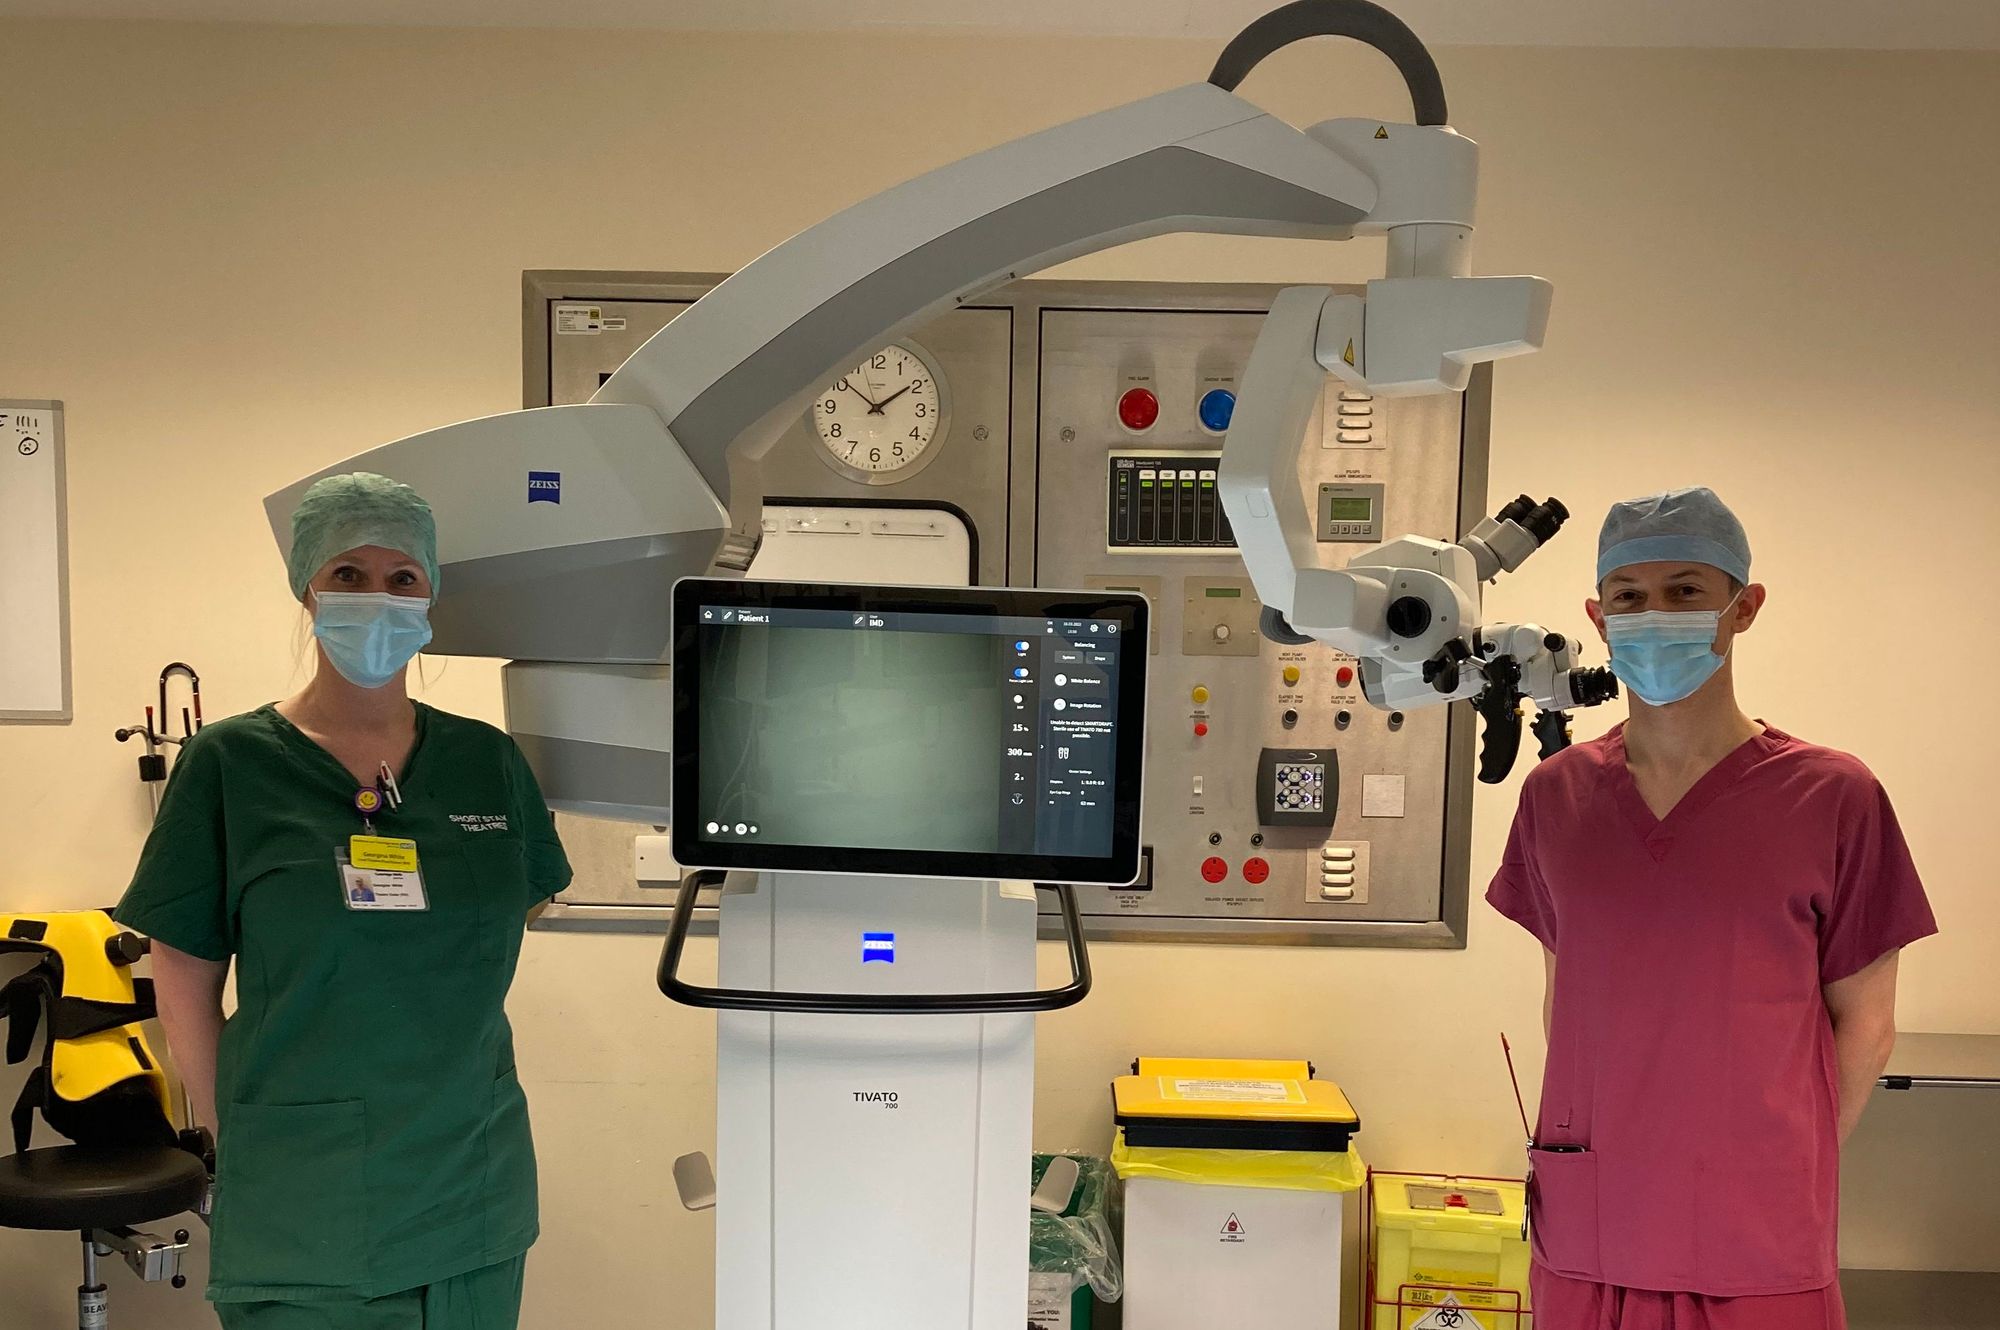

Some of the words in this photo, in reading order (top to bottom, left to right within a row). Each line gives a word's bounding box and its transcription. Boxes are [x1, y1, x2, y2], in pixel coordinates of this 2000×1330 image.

[871, 355, 886, 369] 12
[897, 361, 902, 375] 1
[911, 379, 922, 393] 2
[825, 400, 836, 414] 9
[915, 403, 926, 417] 3
[830, 423, 841, 438] 8
[909, 426, 920, 440] 4
[847, 440, 858, 454] 7
[892, 442, 903, 456] 5
[869, 448, 880, 462] 6
[530, 480, 559, 489] ZEISS
[738, 614, 764, 623] Patient
[1012, 723, 1023, 732] 15
[1007, 748, 1022, 756] 300
[1014, 772, 1020, 781] 2
[449, 814, 481, 822] SHORT
[460, 822, 508, 831] THEATRES
[853, 1092, 898, 1102] TIVATO
